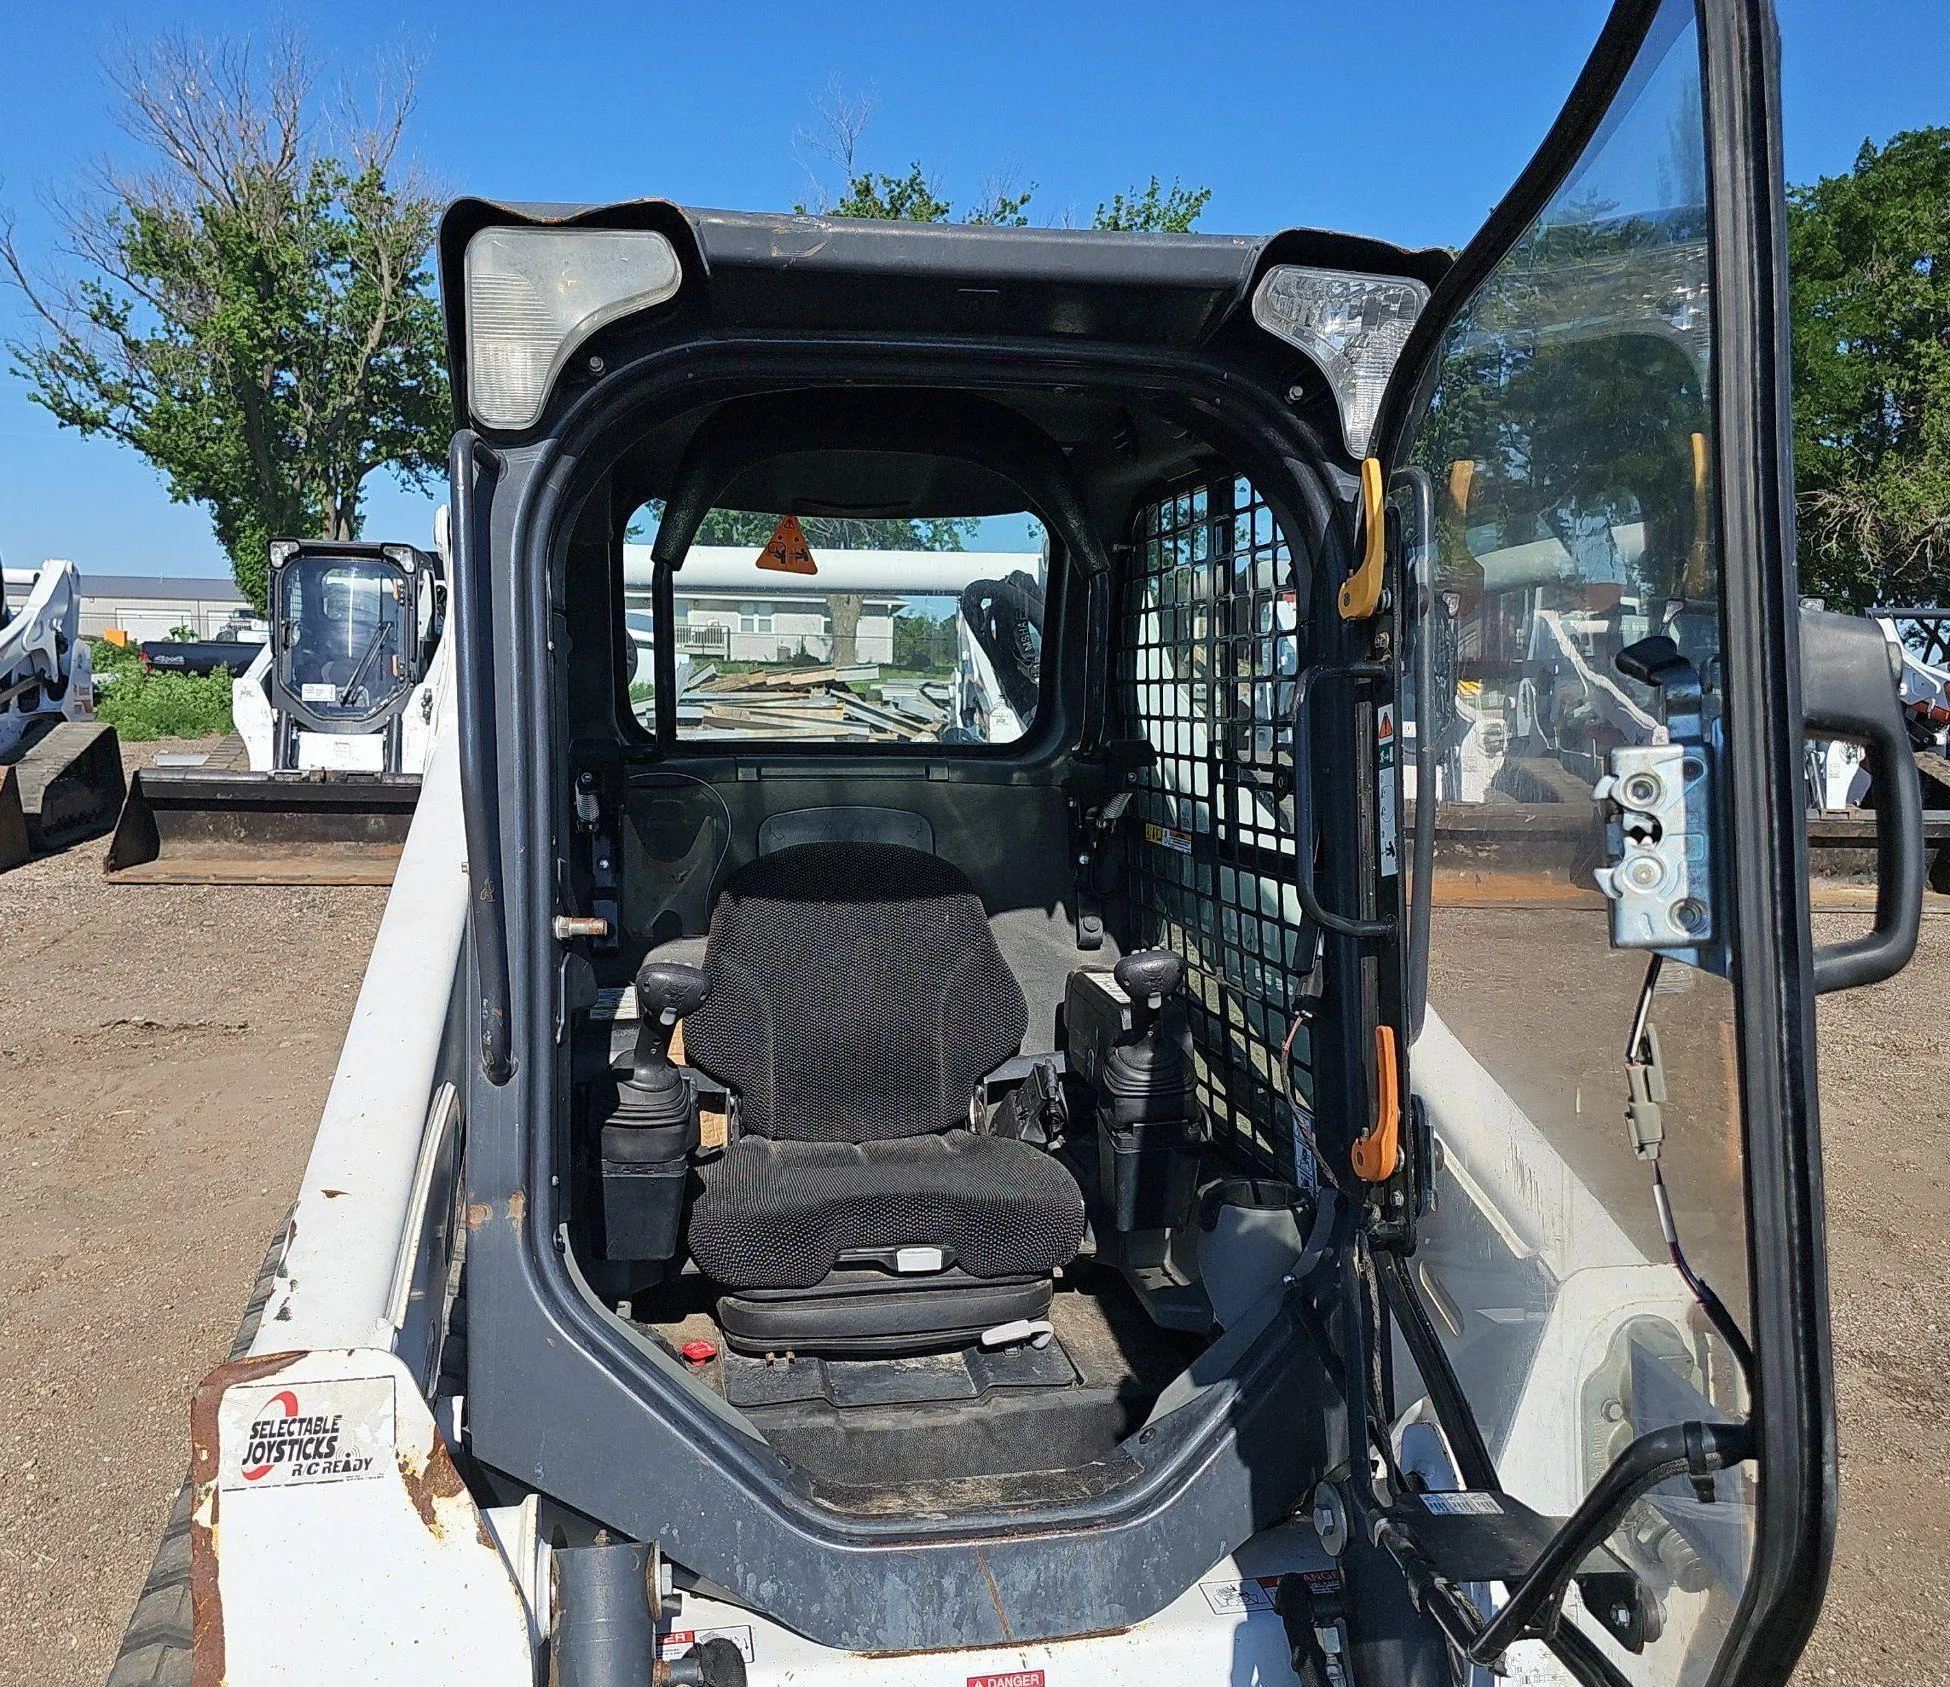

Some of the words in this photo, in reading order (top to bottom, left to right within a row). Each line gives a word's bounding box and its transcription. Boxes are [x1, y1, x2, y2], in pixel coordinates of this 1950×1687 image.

[250, 1415, 343, 1439] SELECTABLE
[242, 1435, 338, 1465] JOYSTICKS
[291, 1462, 320, 1477] R/C
[321, 1457, 374, 1475] READY
[988, 1674, 1039, 1687] DANGER
